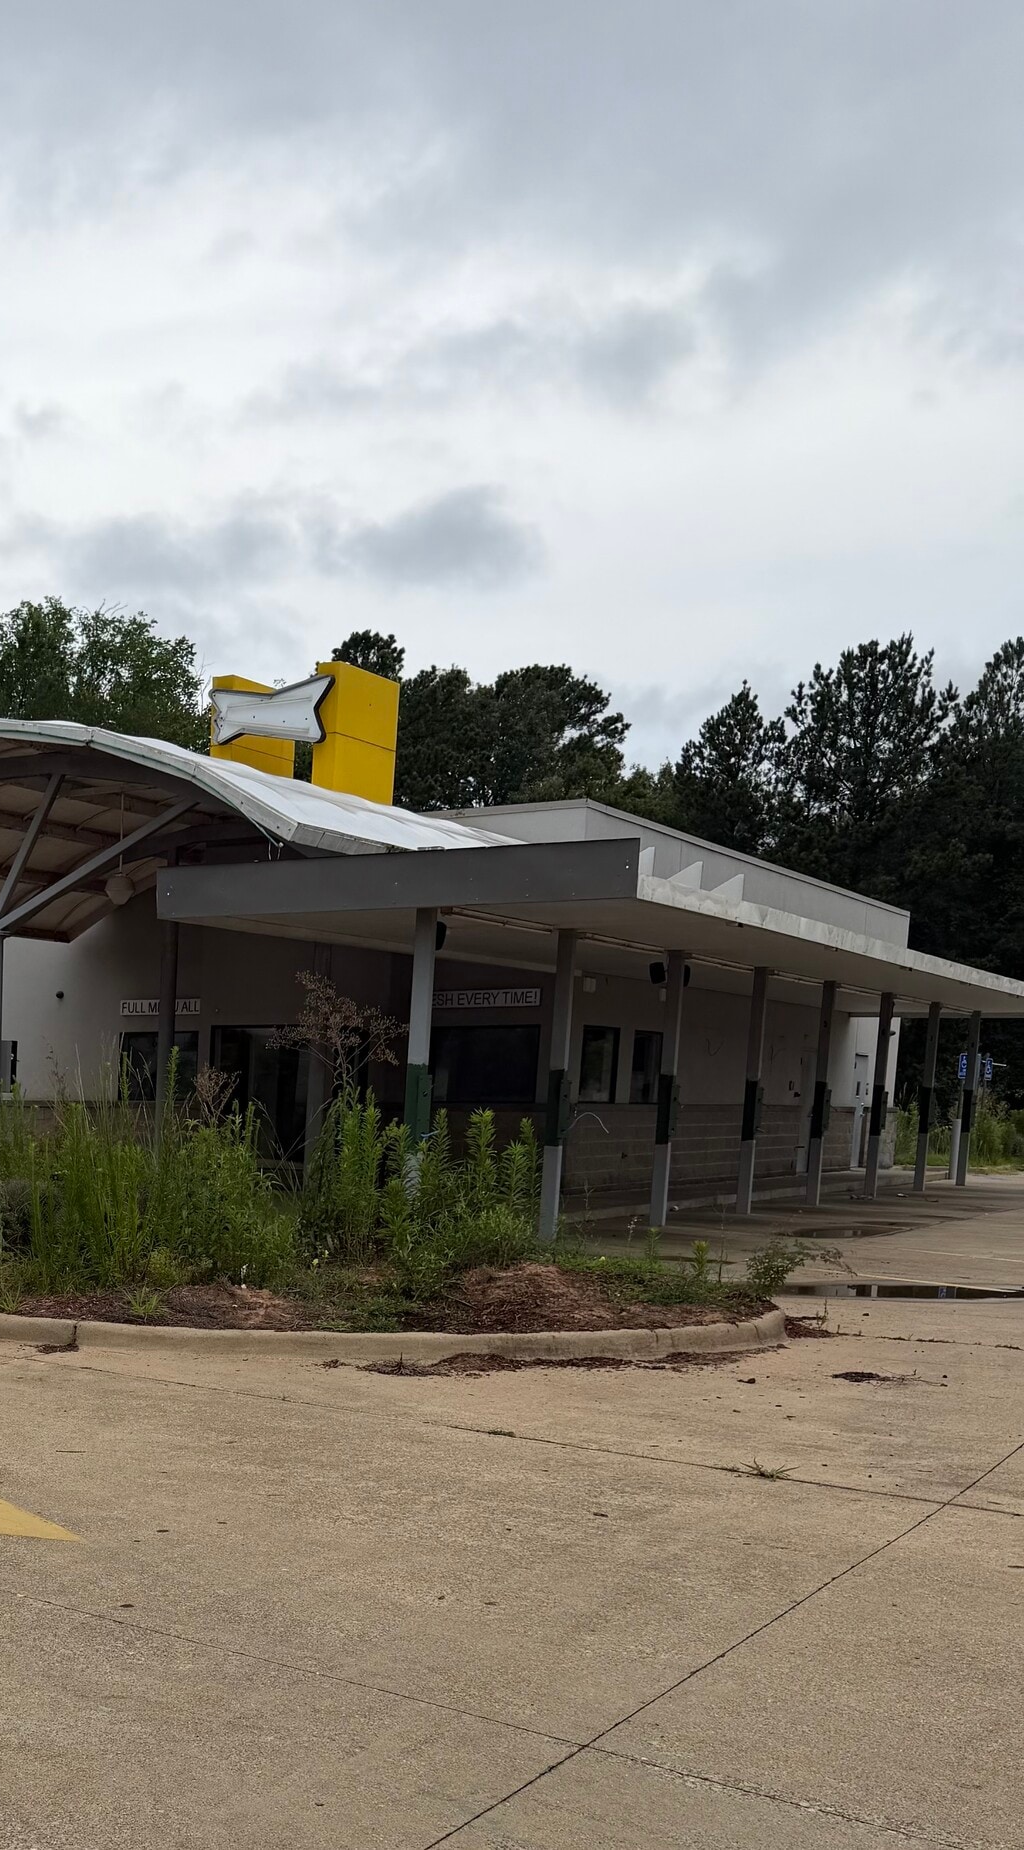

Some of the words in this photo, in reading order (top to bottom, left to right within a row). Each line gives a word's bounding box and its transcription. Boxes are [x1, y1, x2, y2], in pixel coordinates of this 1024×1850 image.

[432, 993, 454, 1007] ESH
[457, 991, 500, 1006] EVERY
[502, 990, 538, 1005] TIME!
[121, 1001, 146, 1014] FULL
[148, 1001, 179, 1013] MU
[181, 1000, 200, 1013] ALL
